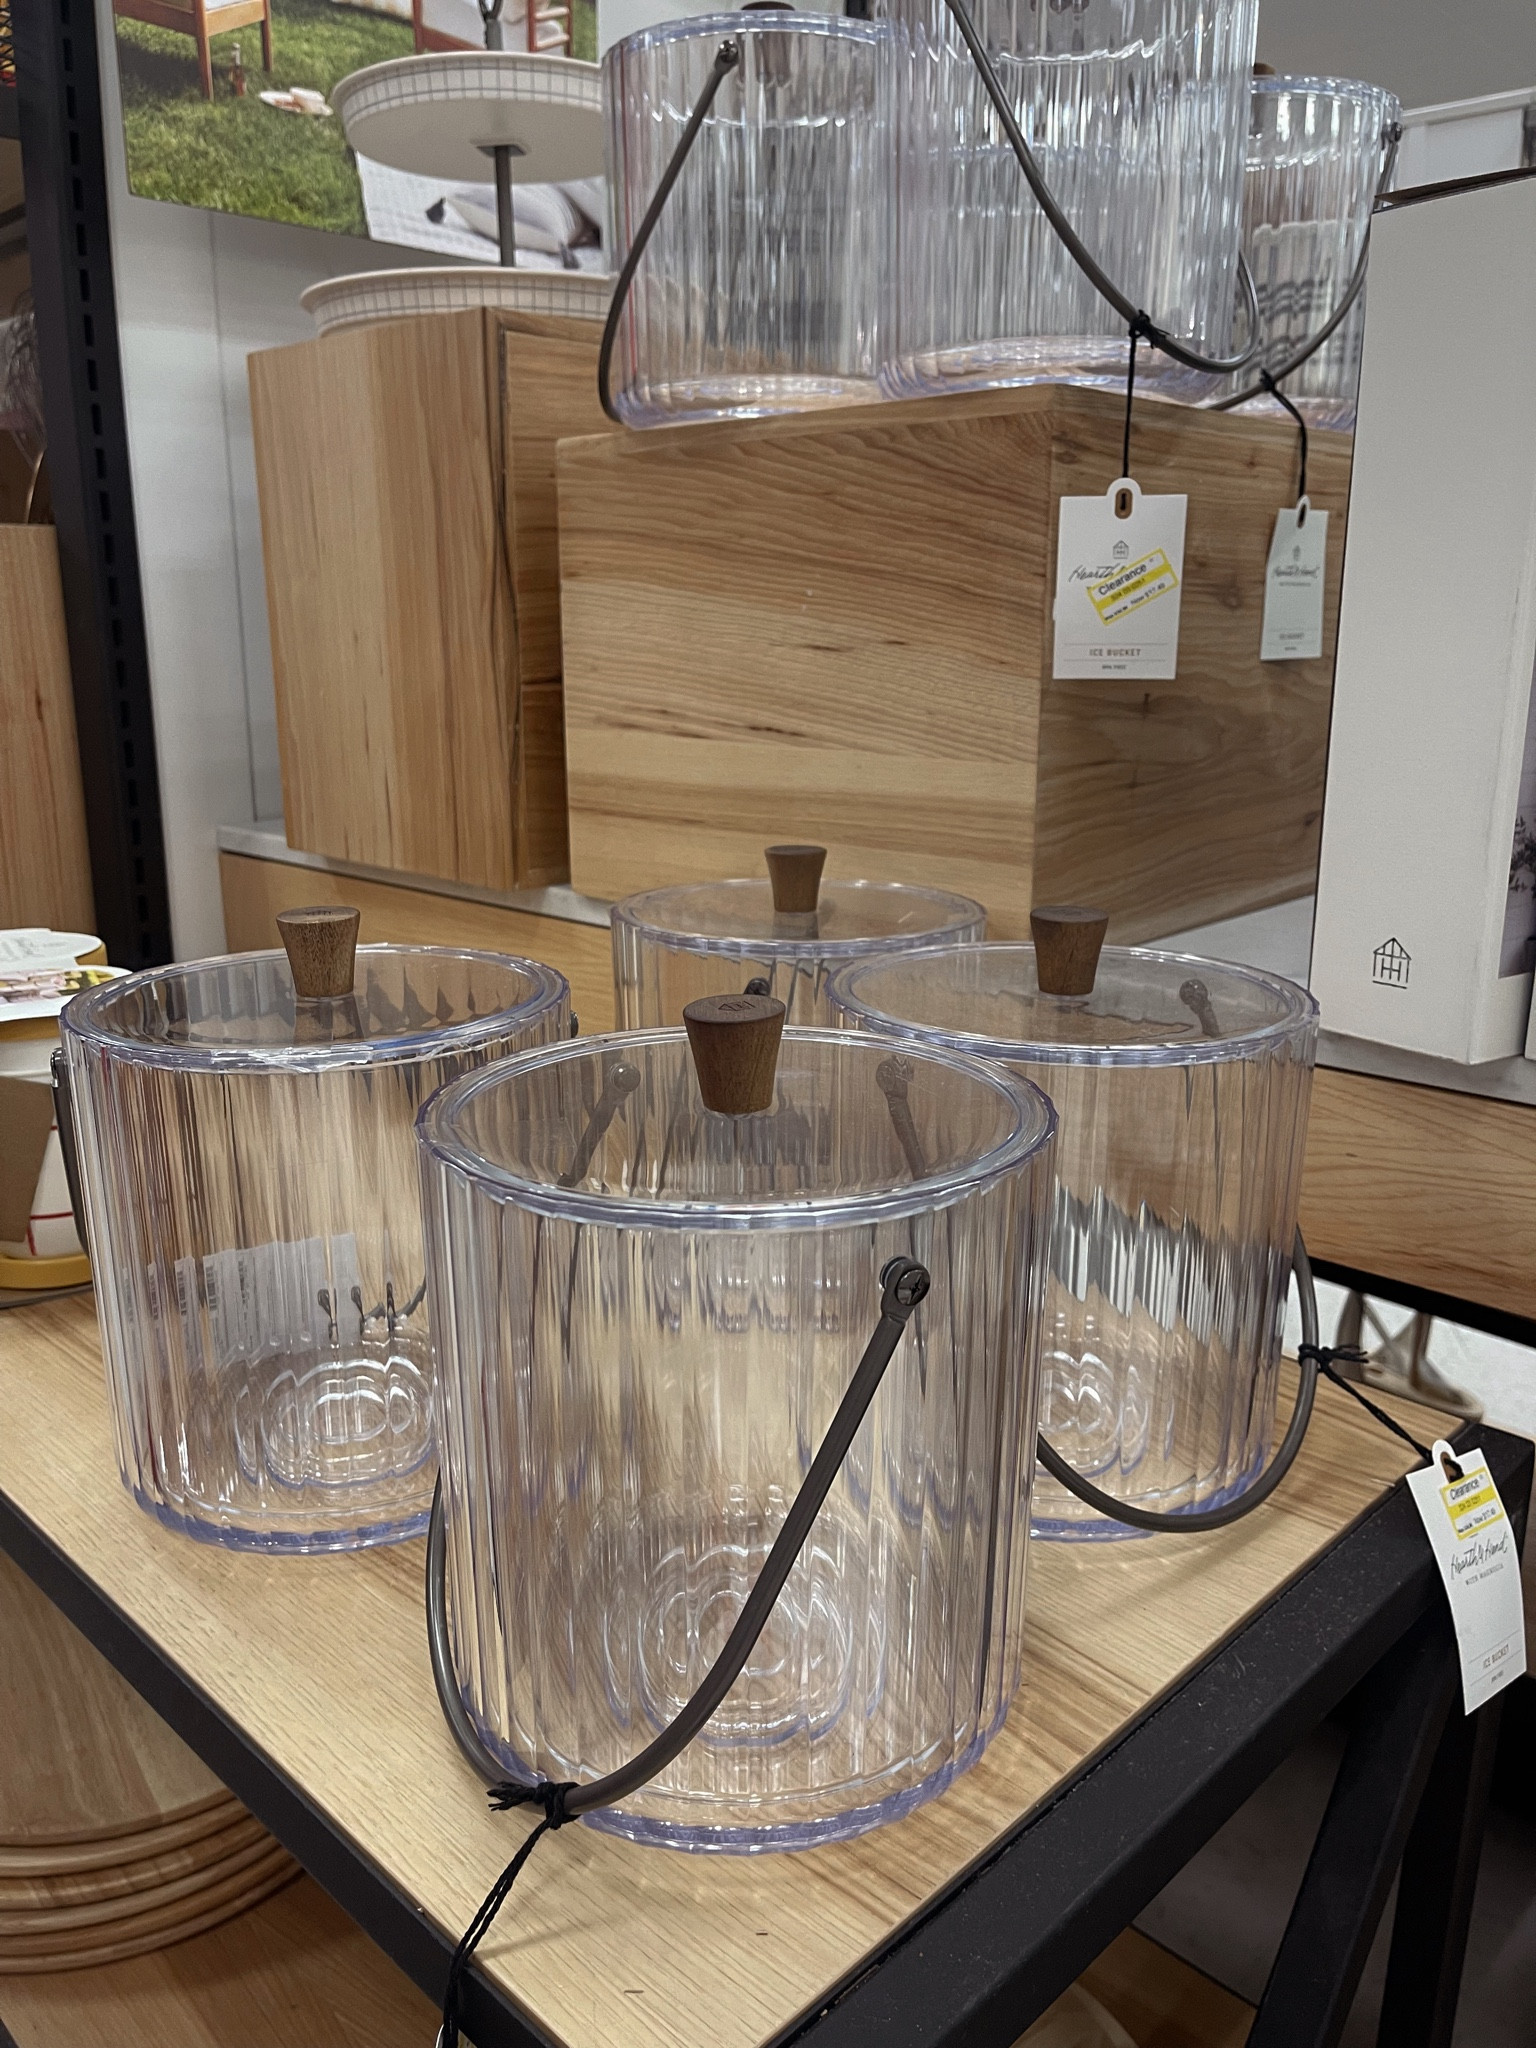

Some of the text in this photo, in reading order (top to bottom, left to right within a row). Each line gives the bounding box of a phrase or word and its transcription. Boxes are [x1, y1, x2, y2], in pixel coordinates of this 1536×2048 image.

[1098, 564, 1147, 596] Clearance
[1089, 648, 1141, 657] ICE BUCKET
[1450, 1478, 1480, 1501] Clearance
